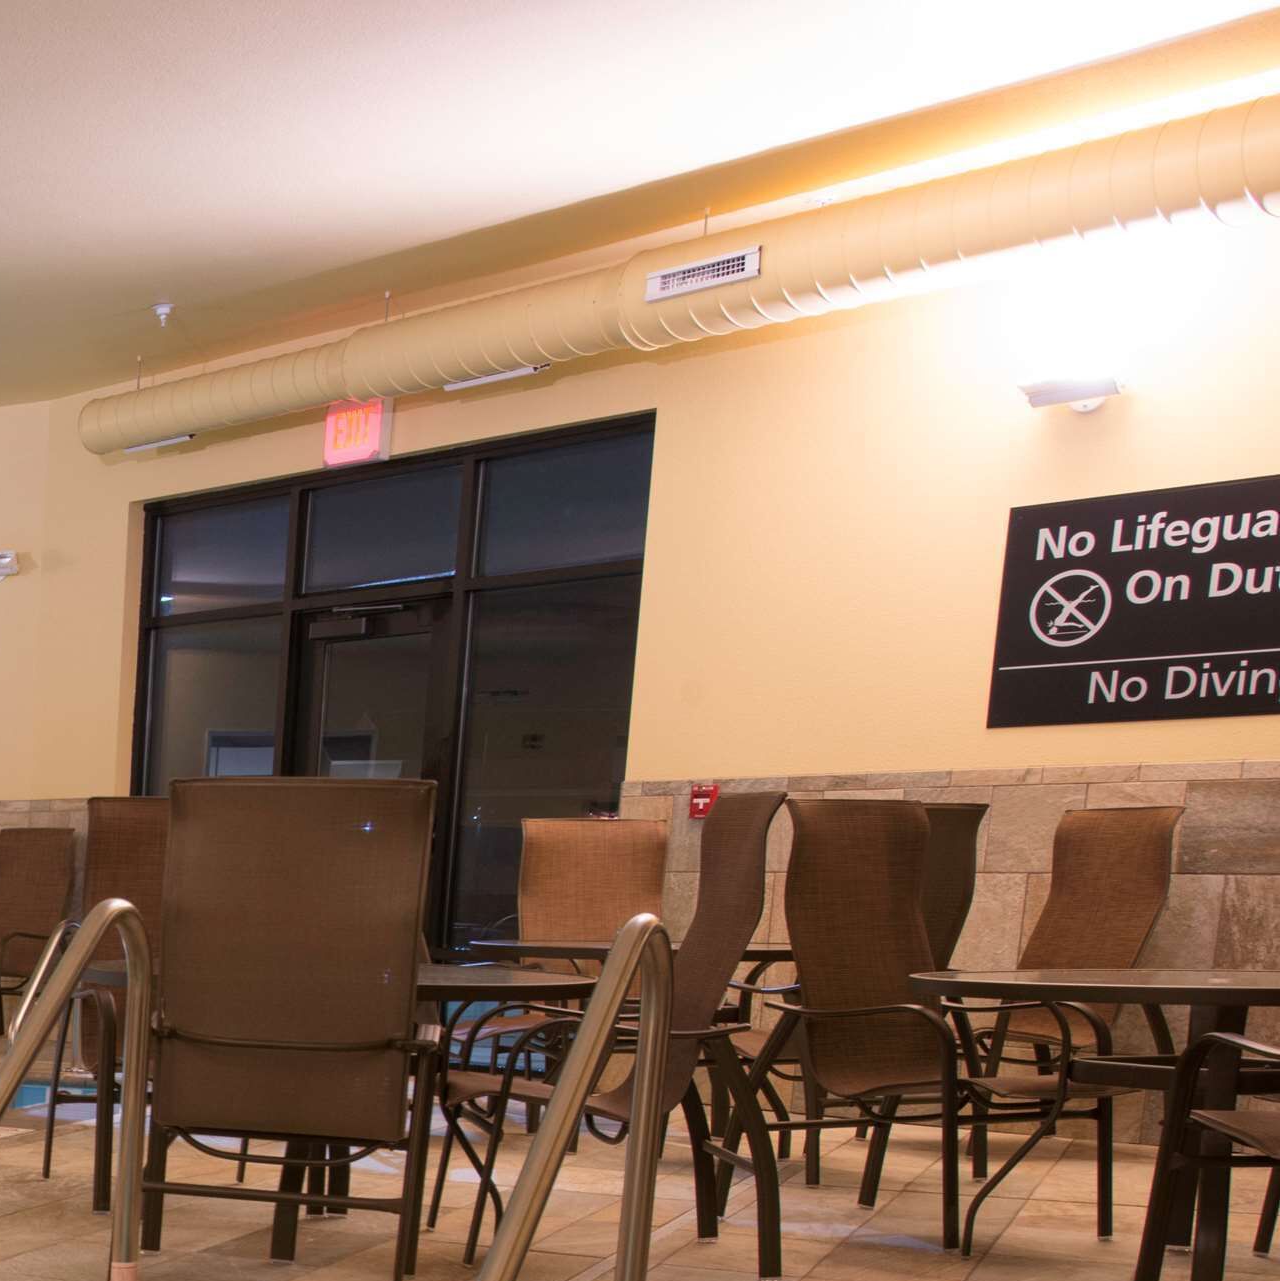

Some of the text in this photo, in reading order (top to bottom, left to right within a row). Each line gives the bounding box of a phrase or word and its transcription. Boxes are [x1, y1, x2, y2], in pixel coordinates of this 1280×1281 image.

[1036, 526, 1096, 560] No
[1126, 570, 1190, 604] On
[1088, 660, 1280, 704] No Divin
